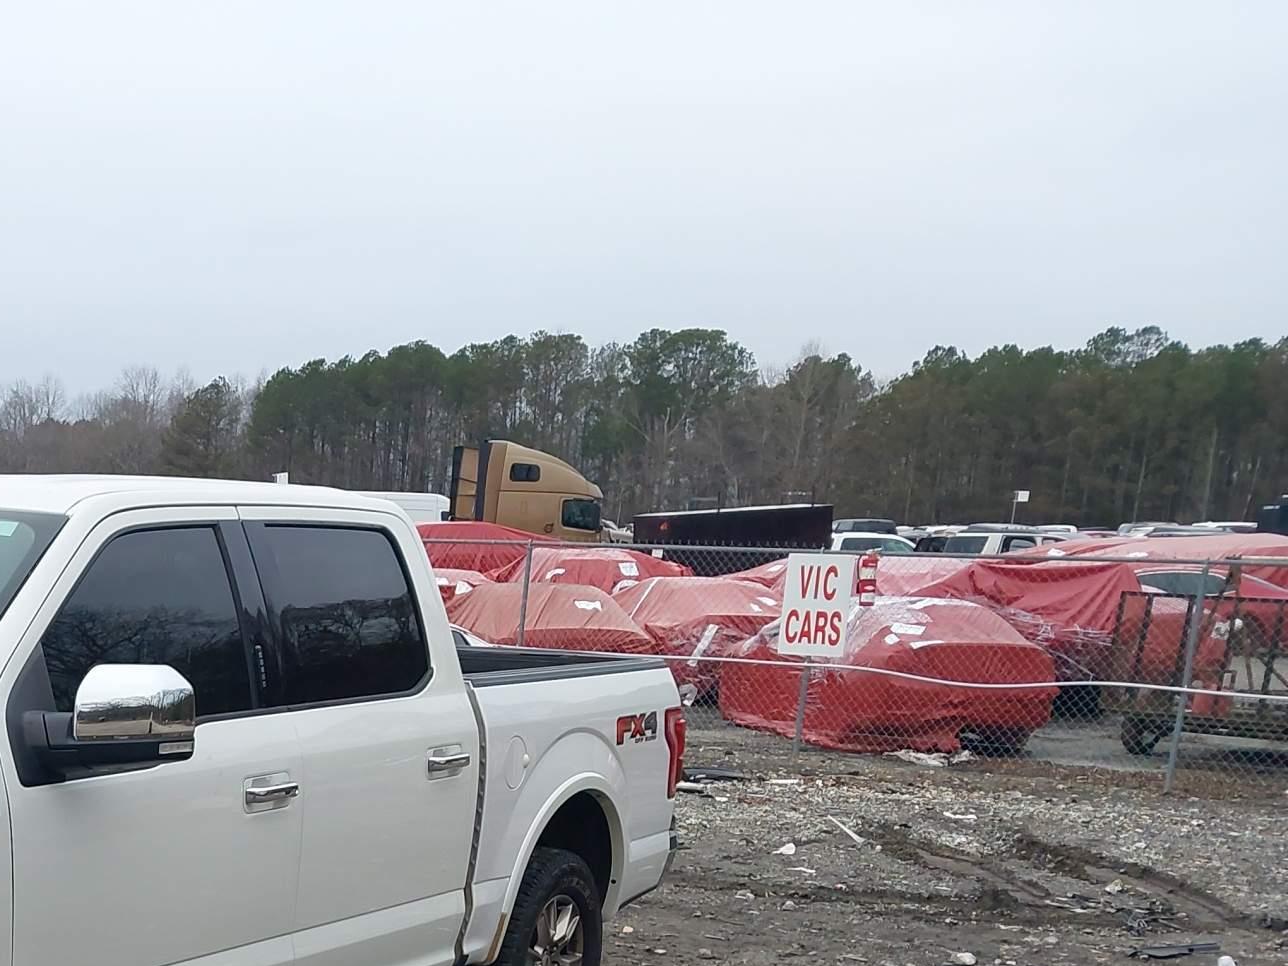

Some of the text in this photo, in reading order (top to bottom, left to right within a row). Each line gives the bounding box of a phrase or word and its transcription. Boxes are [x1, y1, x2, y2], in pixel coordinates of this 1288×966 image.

[800, 565, 839, 601] VIC
[784, 609, 842, 646] CARS
[616, 710, 658, 746] FX4
